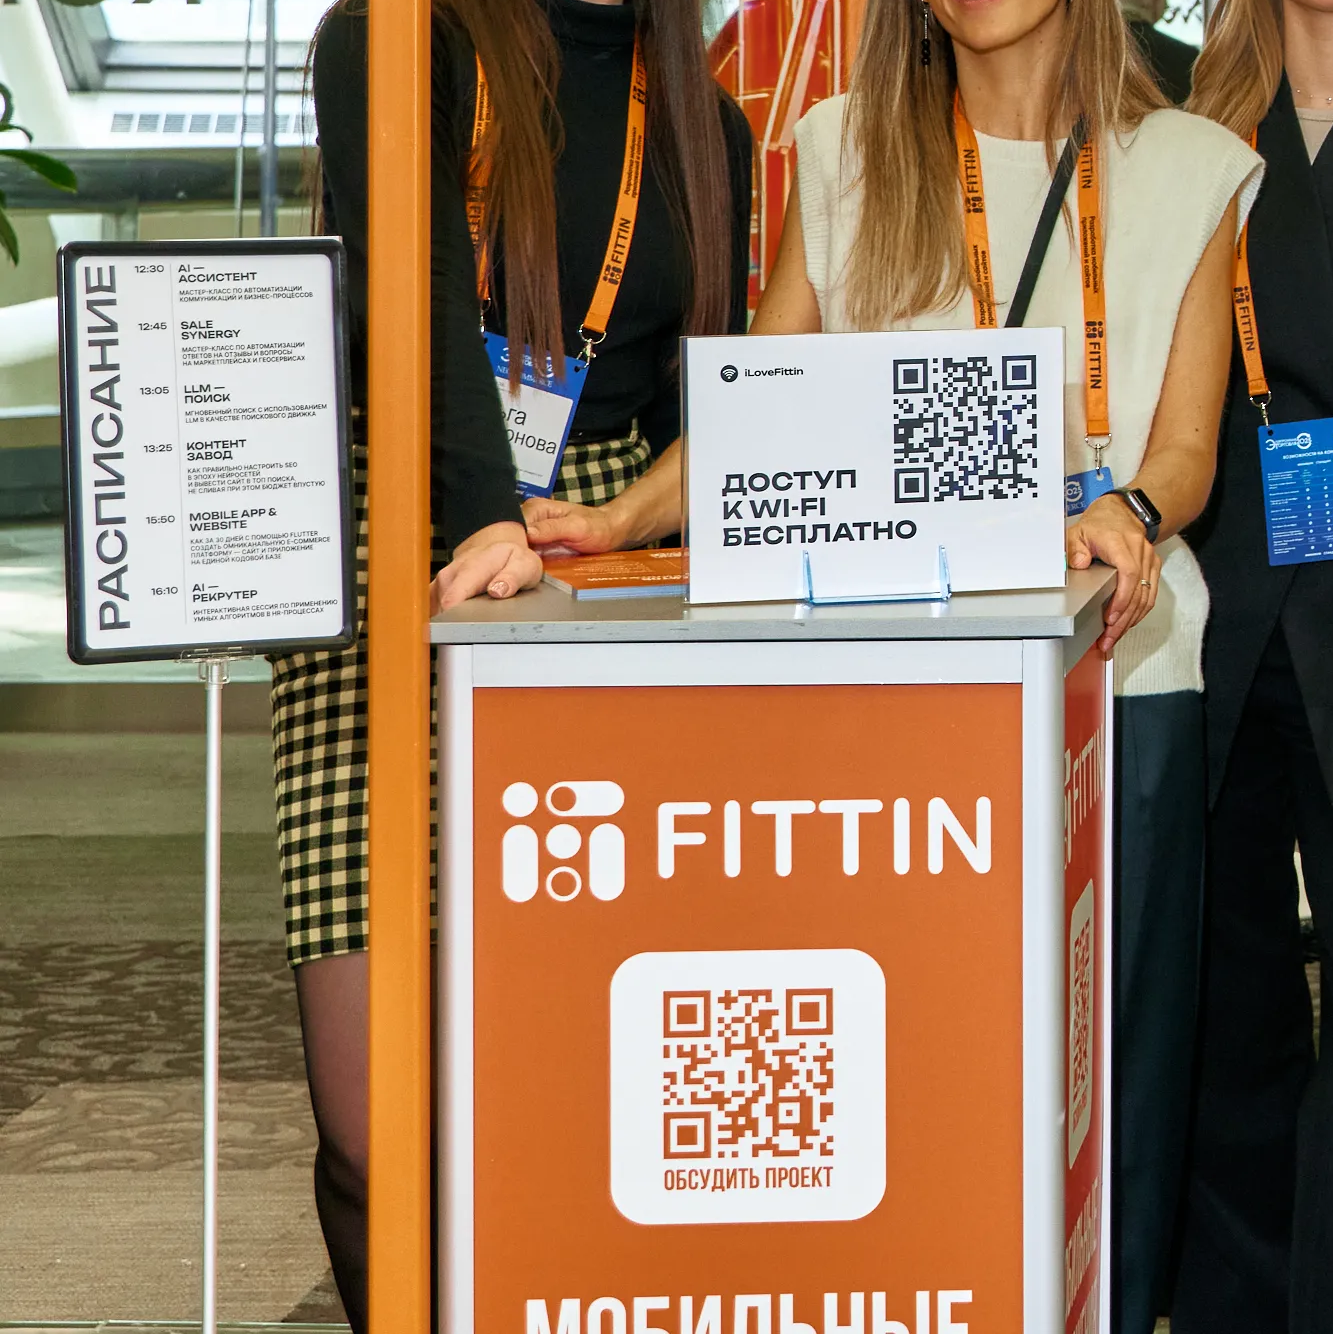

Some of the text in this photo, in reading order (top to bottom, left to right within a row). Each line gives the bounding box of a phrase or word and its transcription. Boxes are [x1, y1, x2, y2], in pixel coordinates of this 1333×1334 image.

[611, 217, 632, 264] FITTIN
[134, 264, 164, 273] 12:30
[178, 271, 256, 282] АССИСТЕНТ
[137, 322, 167, 330] 12:45
[180, 320, 213, 329] SALE
[181, 329, 240, 339] SYNERGY
[1089, 342, 1102, 389] FITTIN
[744, 367, 803, 376] iLoveFittin
[139, 386, 169, 395] 13:05
[183, 383, 210, 393] LLM
[184, 393, 230, 403] ПОИСК
[85, 265, 131, 630] РАСПИСАНИЕ
[143, 443, 172, 452] 13:25
[186, 439, 246, 450] КОНТЕНТ
[187, 450, 232, 460] ЗАВОД
[721, 469, 856, 496] ДОСТУП
[723, 496, 825, 519] К WI-FI
[145, 515, 175, 524] 15:50
[189, 510, 238, 521] MOBILE
[240, 508, 265, 518] APP
[189, 519, 246, 531] WEBSITE
[722, 519, 917, 546] БЕСПЛАТНО
[150, 586, 178, 595] 16:10
[192, 589, 257, 602] РЕКРУТЕР
[657, 797, 992, 879] FITTIN
[664, 1166, 833, 1192] ОБСУДИТЬ ПРОЕКТ
